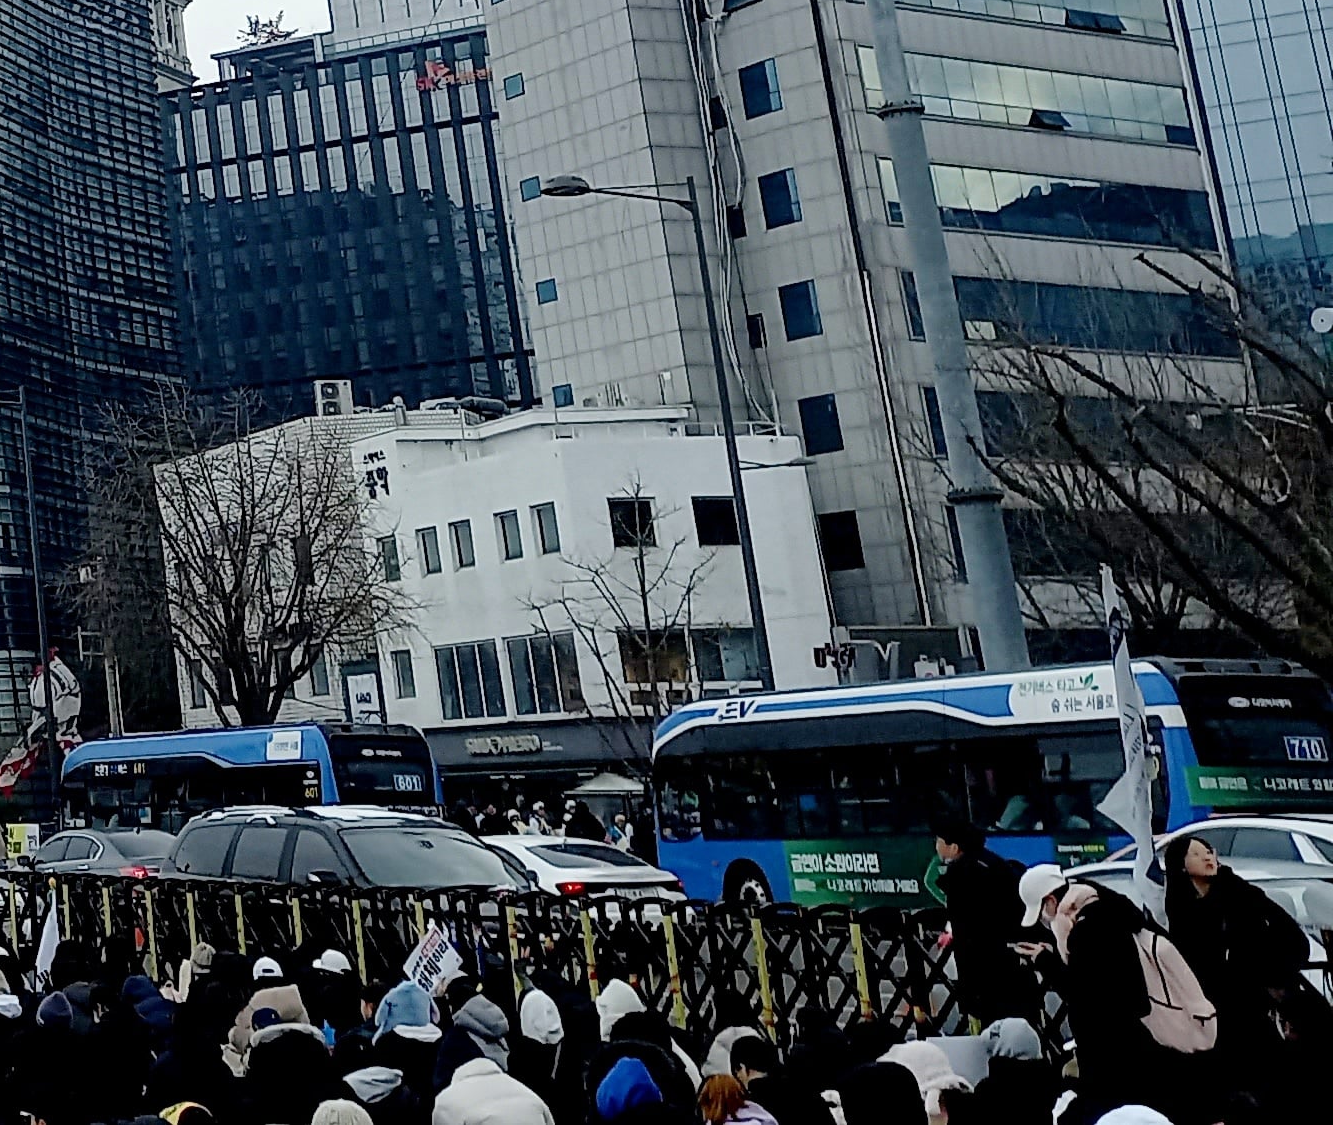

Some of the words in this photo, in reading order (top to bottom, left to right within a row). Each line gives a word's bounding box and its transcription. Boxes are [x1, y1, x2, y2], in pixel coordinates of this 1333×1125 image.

[1056, 677, 1076, 692] 타고
[721, 700, 755, 721] EV
[1063, 696, 1083, 713] 쉬는
[1289, 738, 1322, 759] 710
[398, 776, 420, 791] 601
[304, 786, 318, 799] 601
